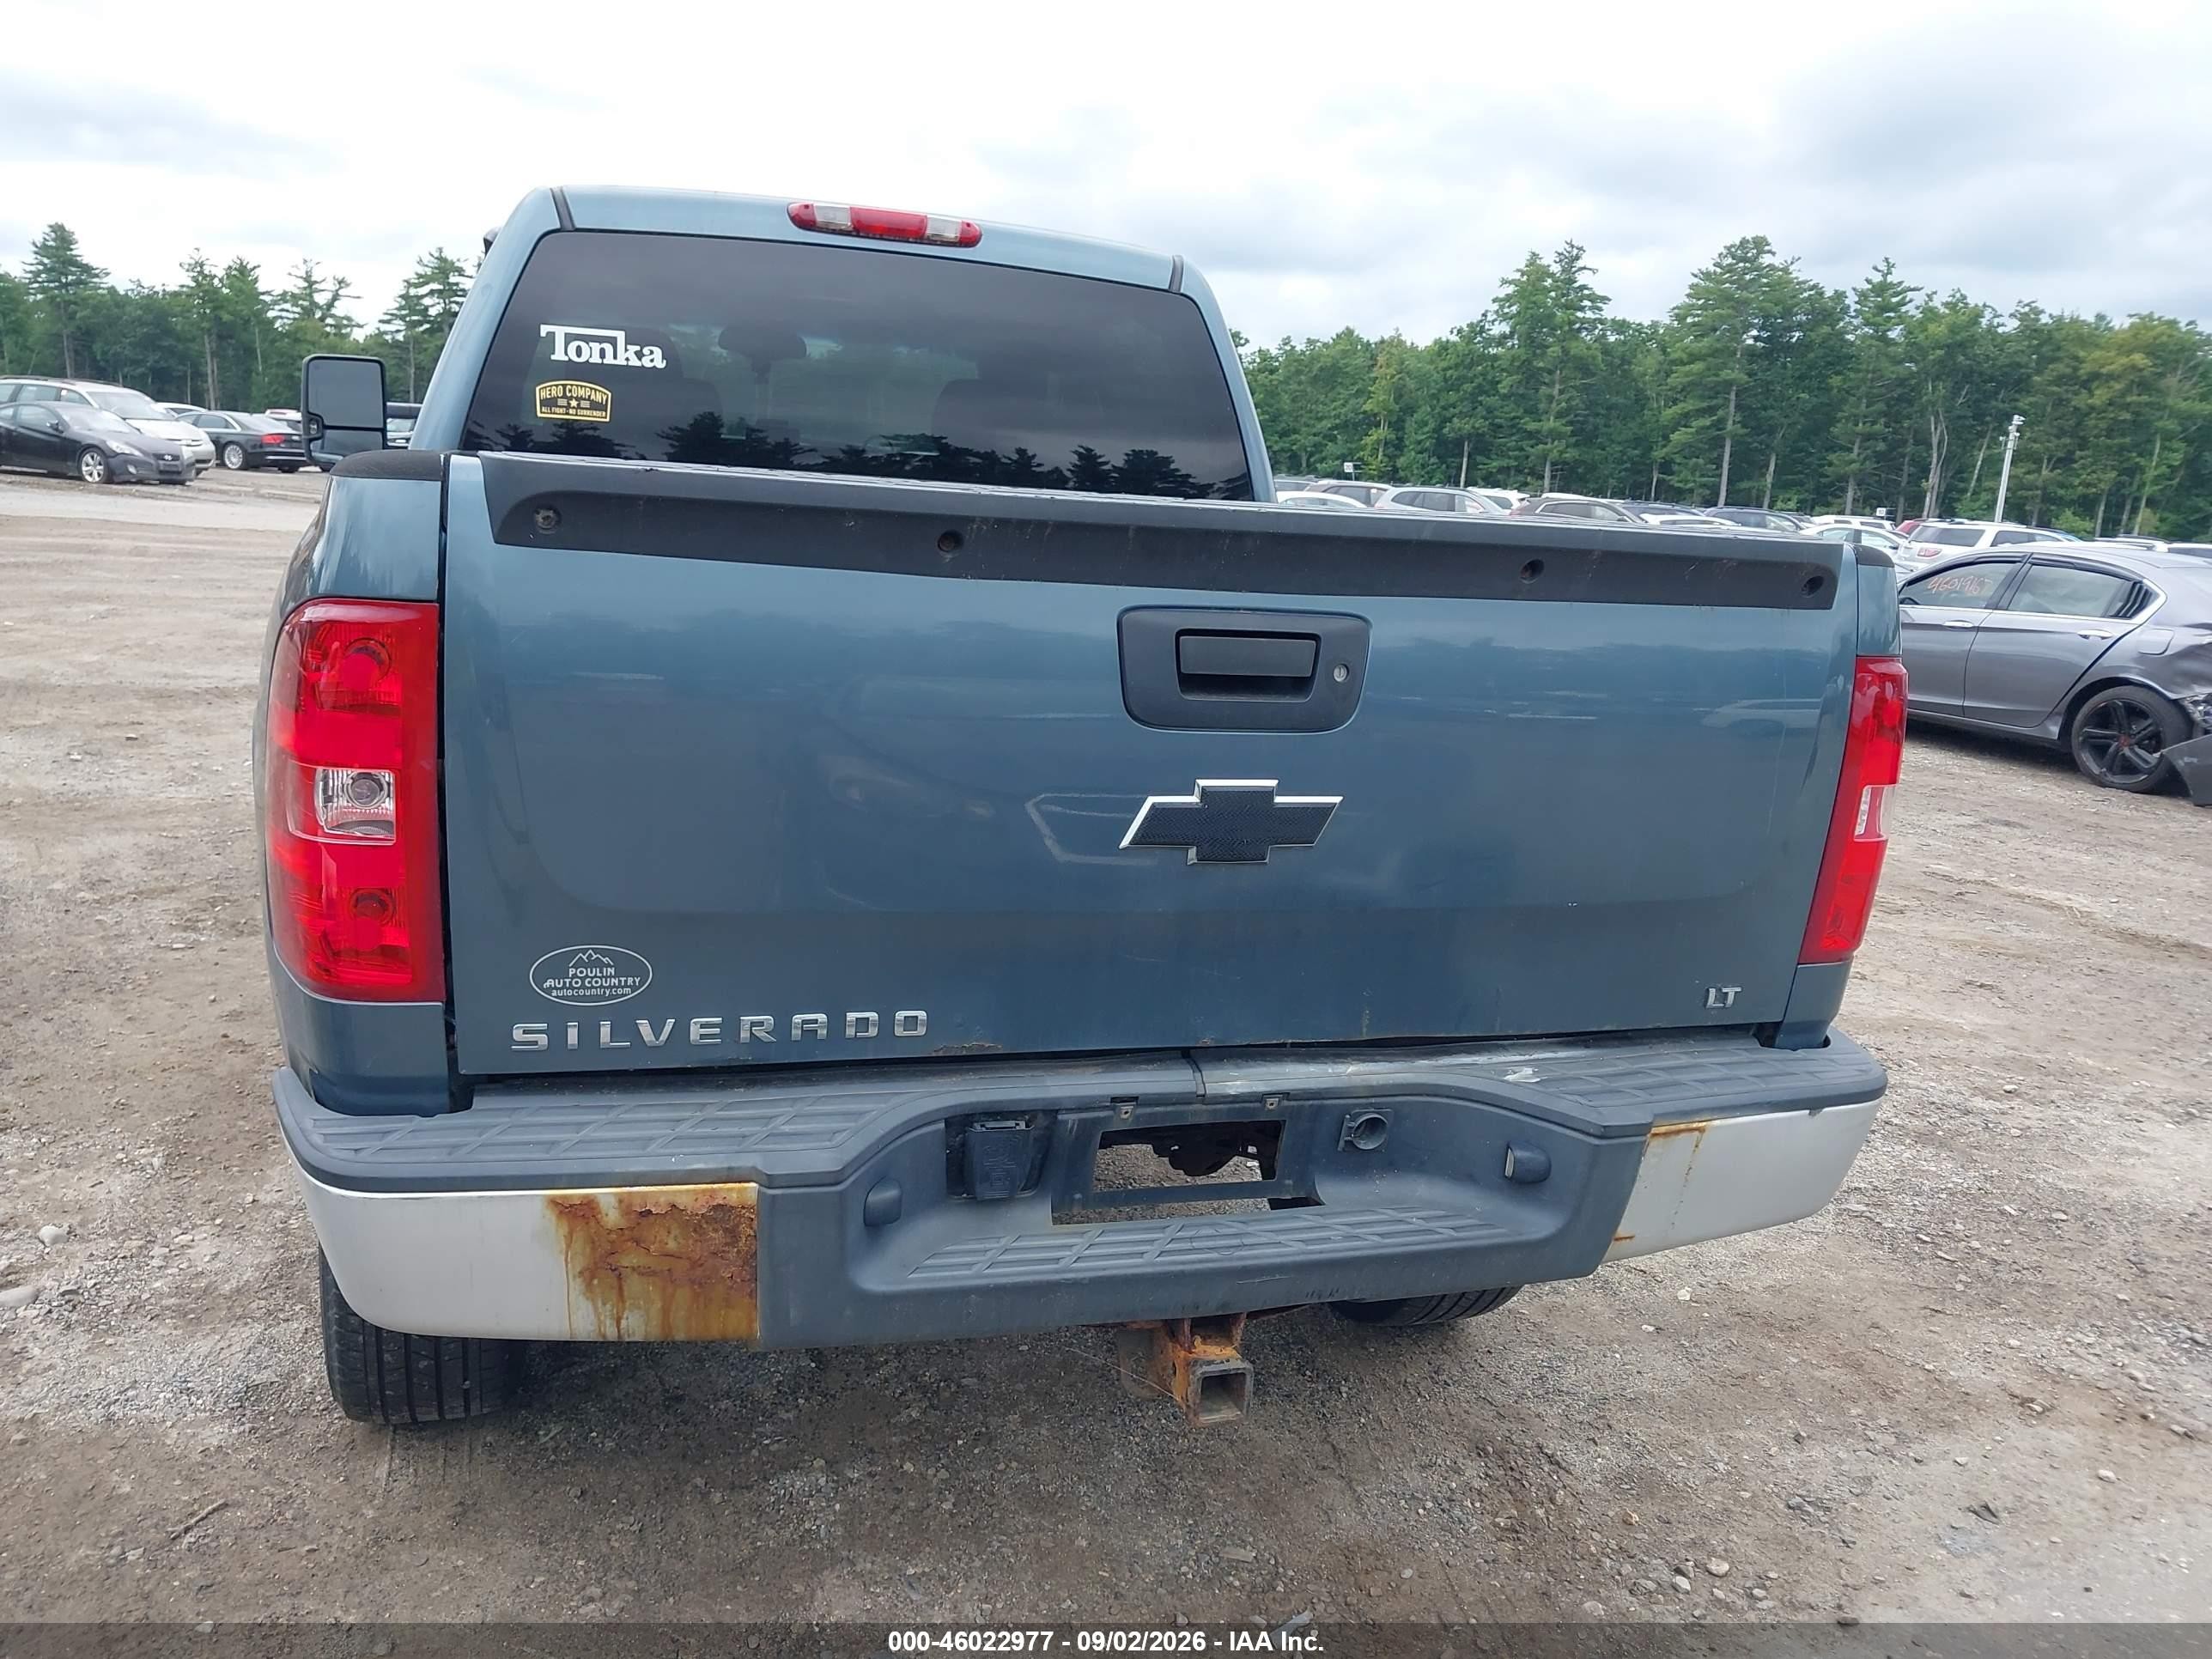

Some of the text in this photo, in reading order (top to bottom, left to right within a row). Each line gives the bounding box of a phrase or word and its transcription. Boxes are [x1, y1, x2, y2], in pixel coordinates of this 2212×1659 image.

[539, 324, 666, 369] Tonka
[540, 385, 607, 405] HERO COMPANY
[544, 976, 641, 988] AUTO COUNTRY
[568, 967, 615, 977] POULIN
[551, 988, 632, 997] autocountry.com
[1705, 987, 1742, 1009] LT
[511, 1010, 927, 1051] SILVERADO
